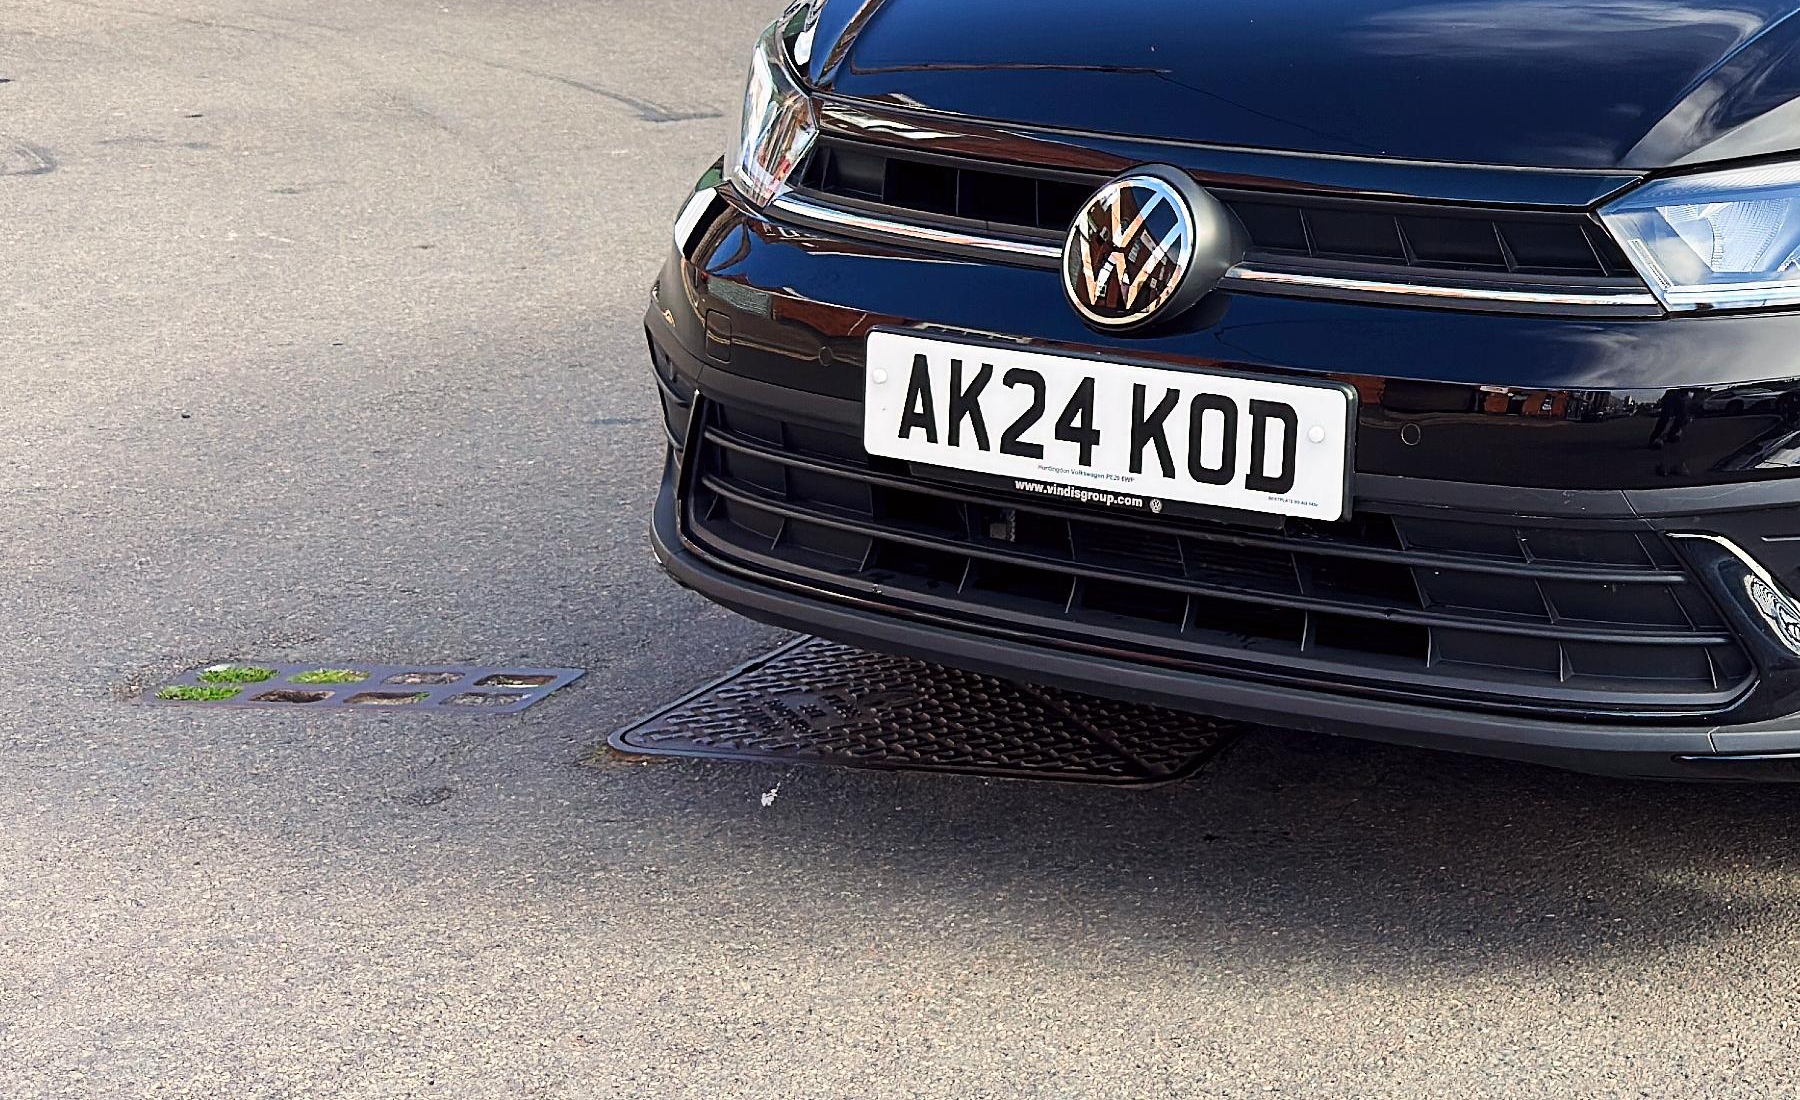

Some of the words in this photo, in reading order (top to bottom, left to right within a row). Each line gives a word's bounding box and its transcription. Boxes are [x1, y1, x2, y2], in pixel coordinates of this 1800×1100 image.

[898, 353, 1101, 467] AK24
[1129, 383, 1298, 495] KOD
[1015, 479, 1143, 508] www.vindisgroup.com
